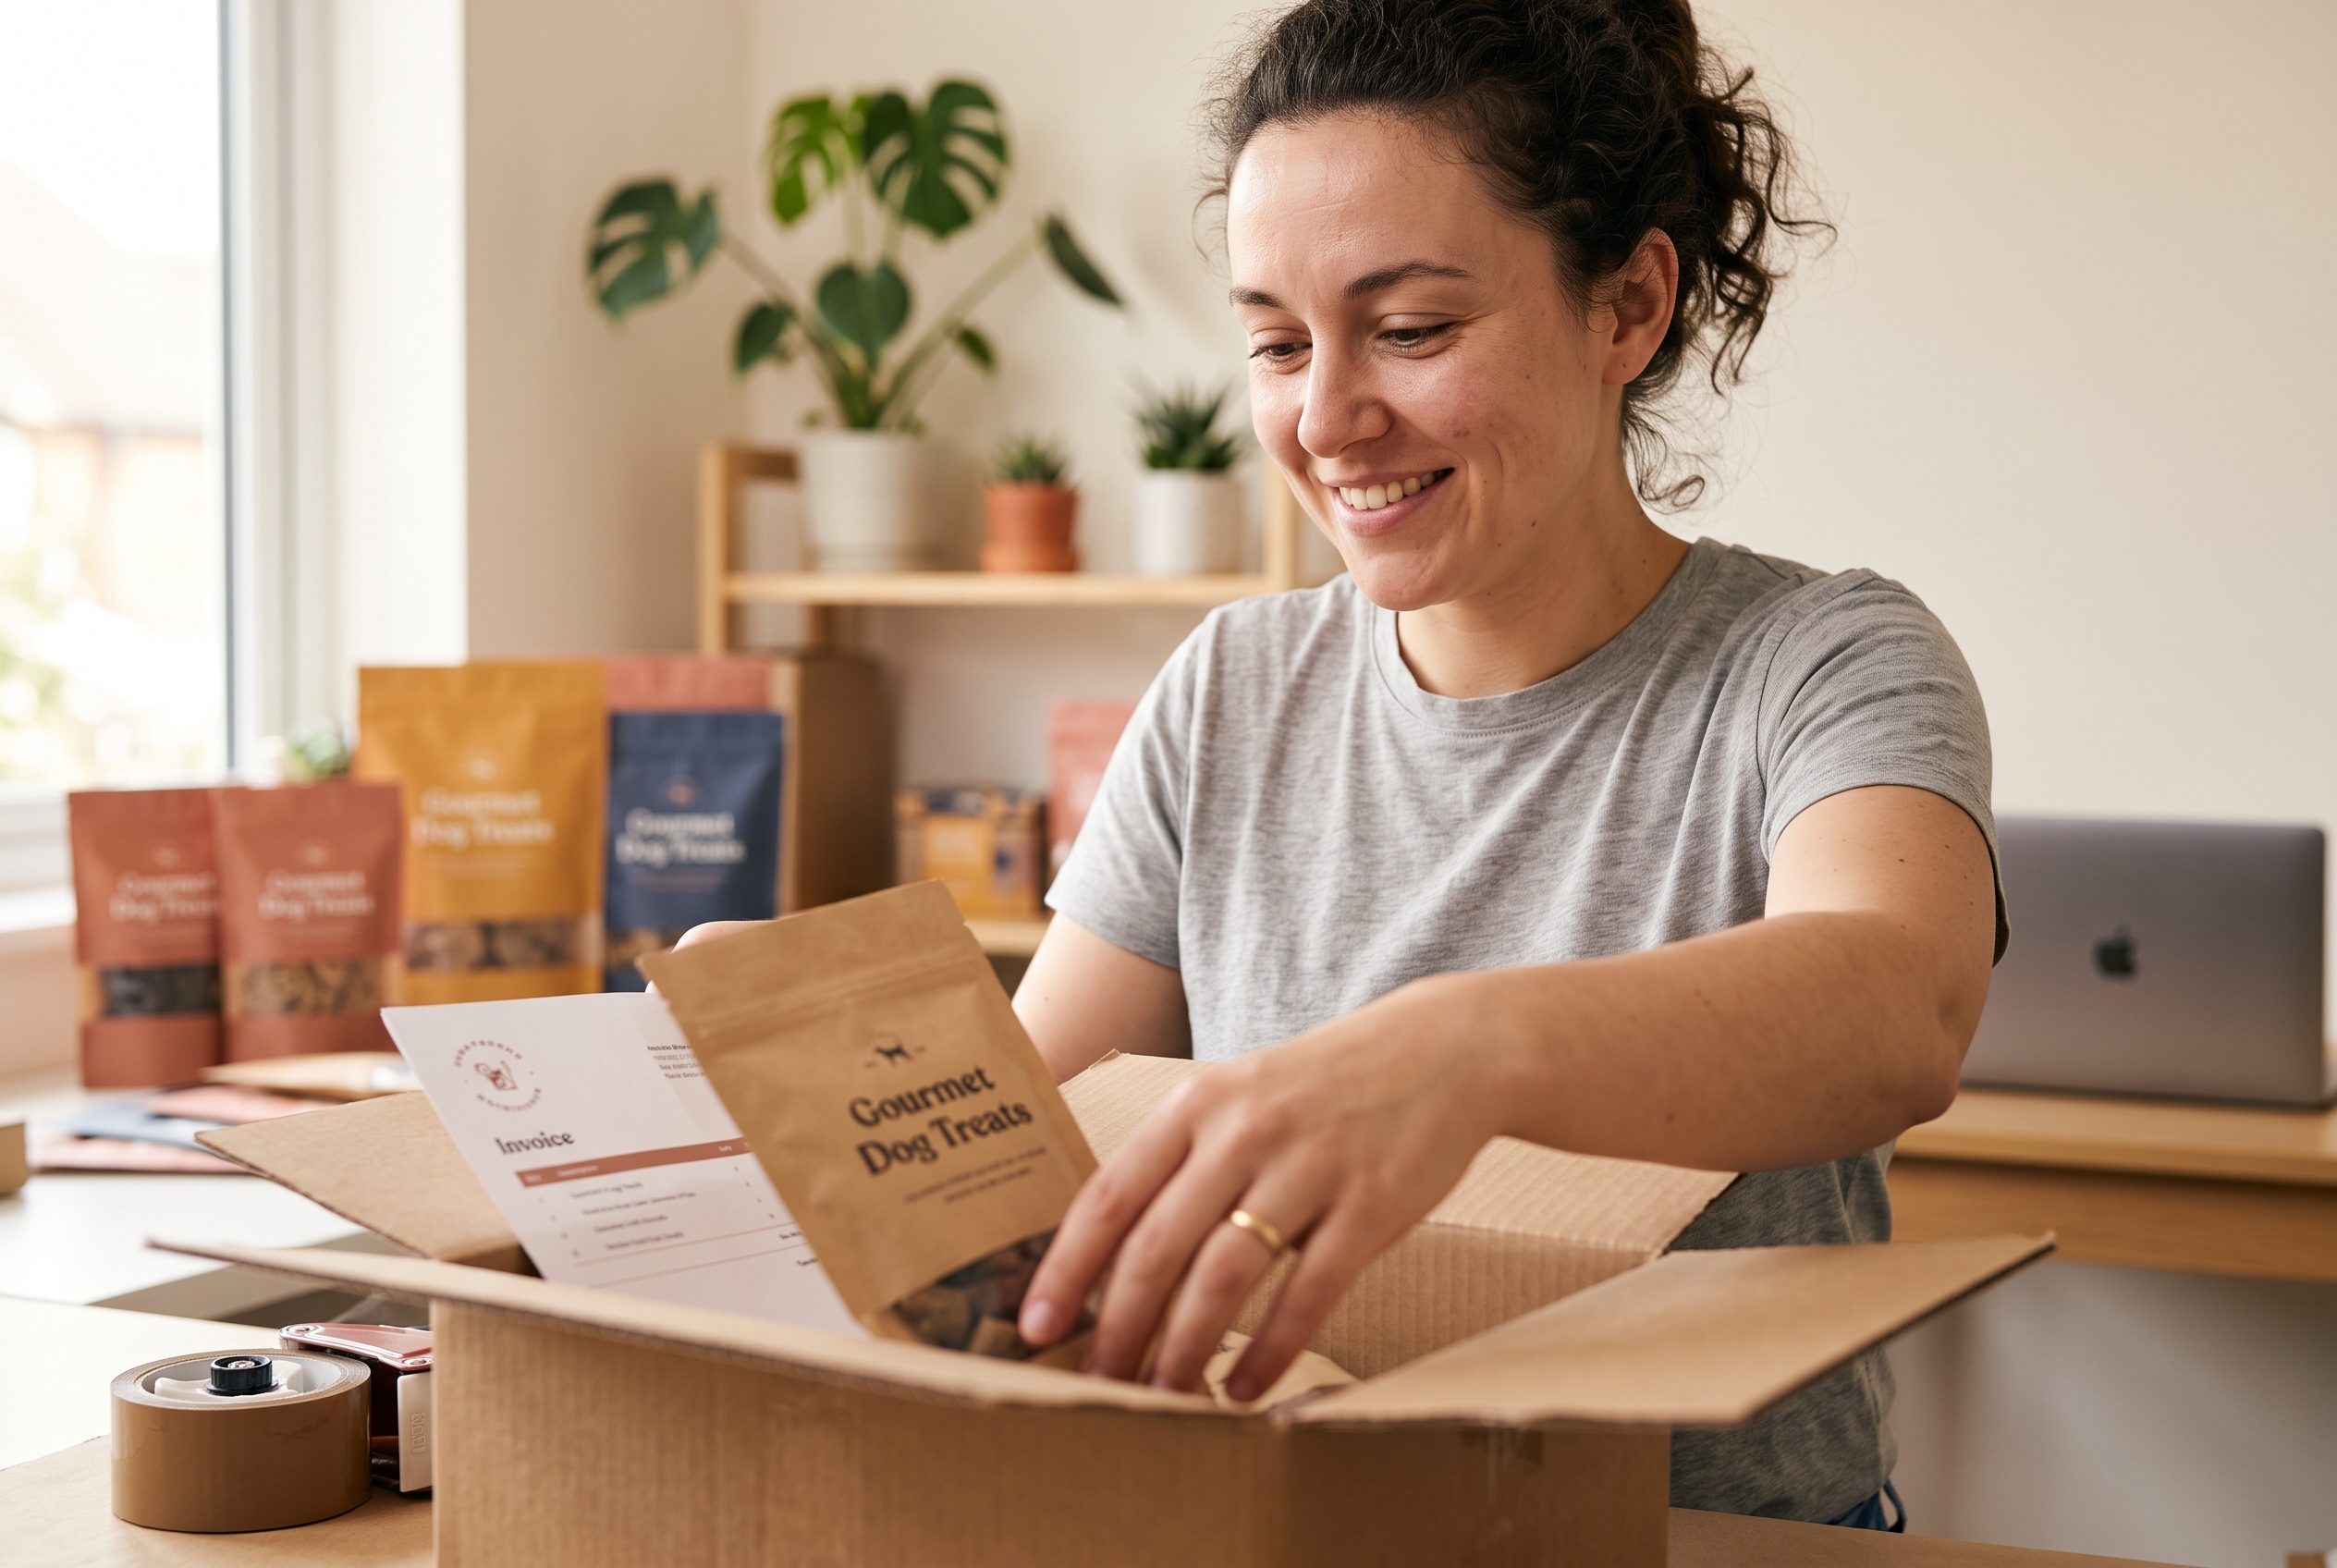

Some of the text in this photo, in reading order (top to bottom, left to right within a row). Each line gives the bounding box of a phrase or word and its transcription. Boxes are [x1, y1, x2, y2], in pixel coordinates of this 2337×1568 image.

[849, 1065, 996, 1128] Gourmet
[496, 1131, 574, 1156] Invoice
[856, 1133, 938, 1176] Dog
[929, 1100, 1034, 1148] Treats
